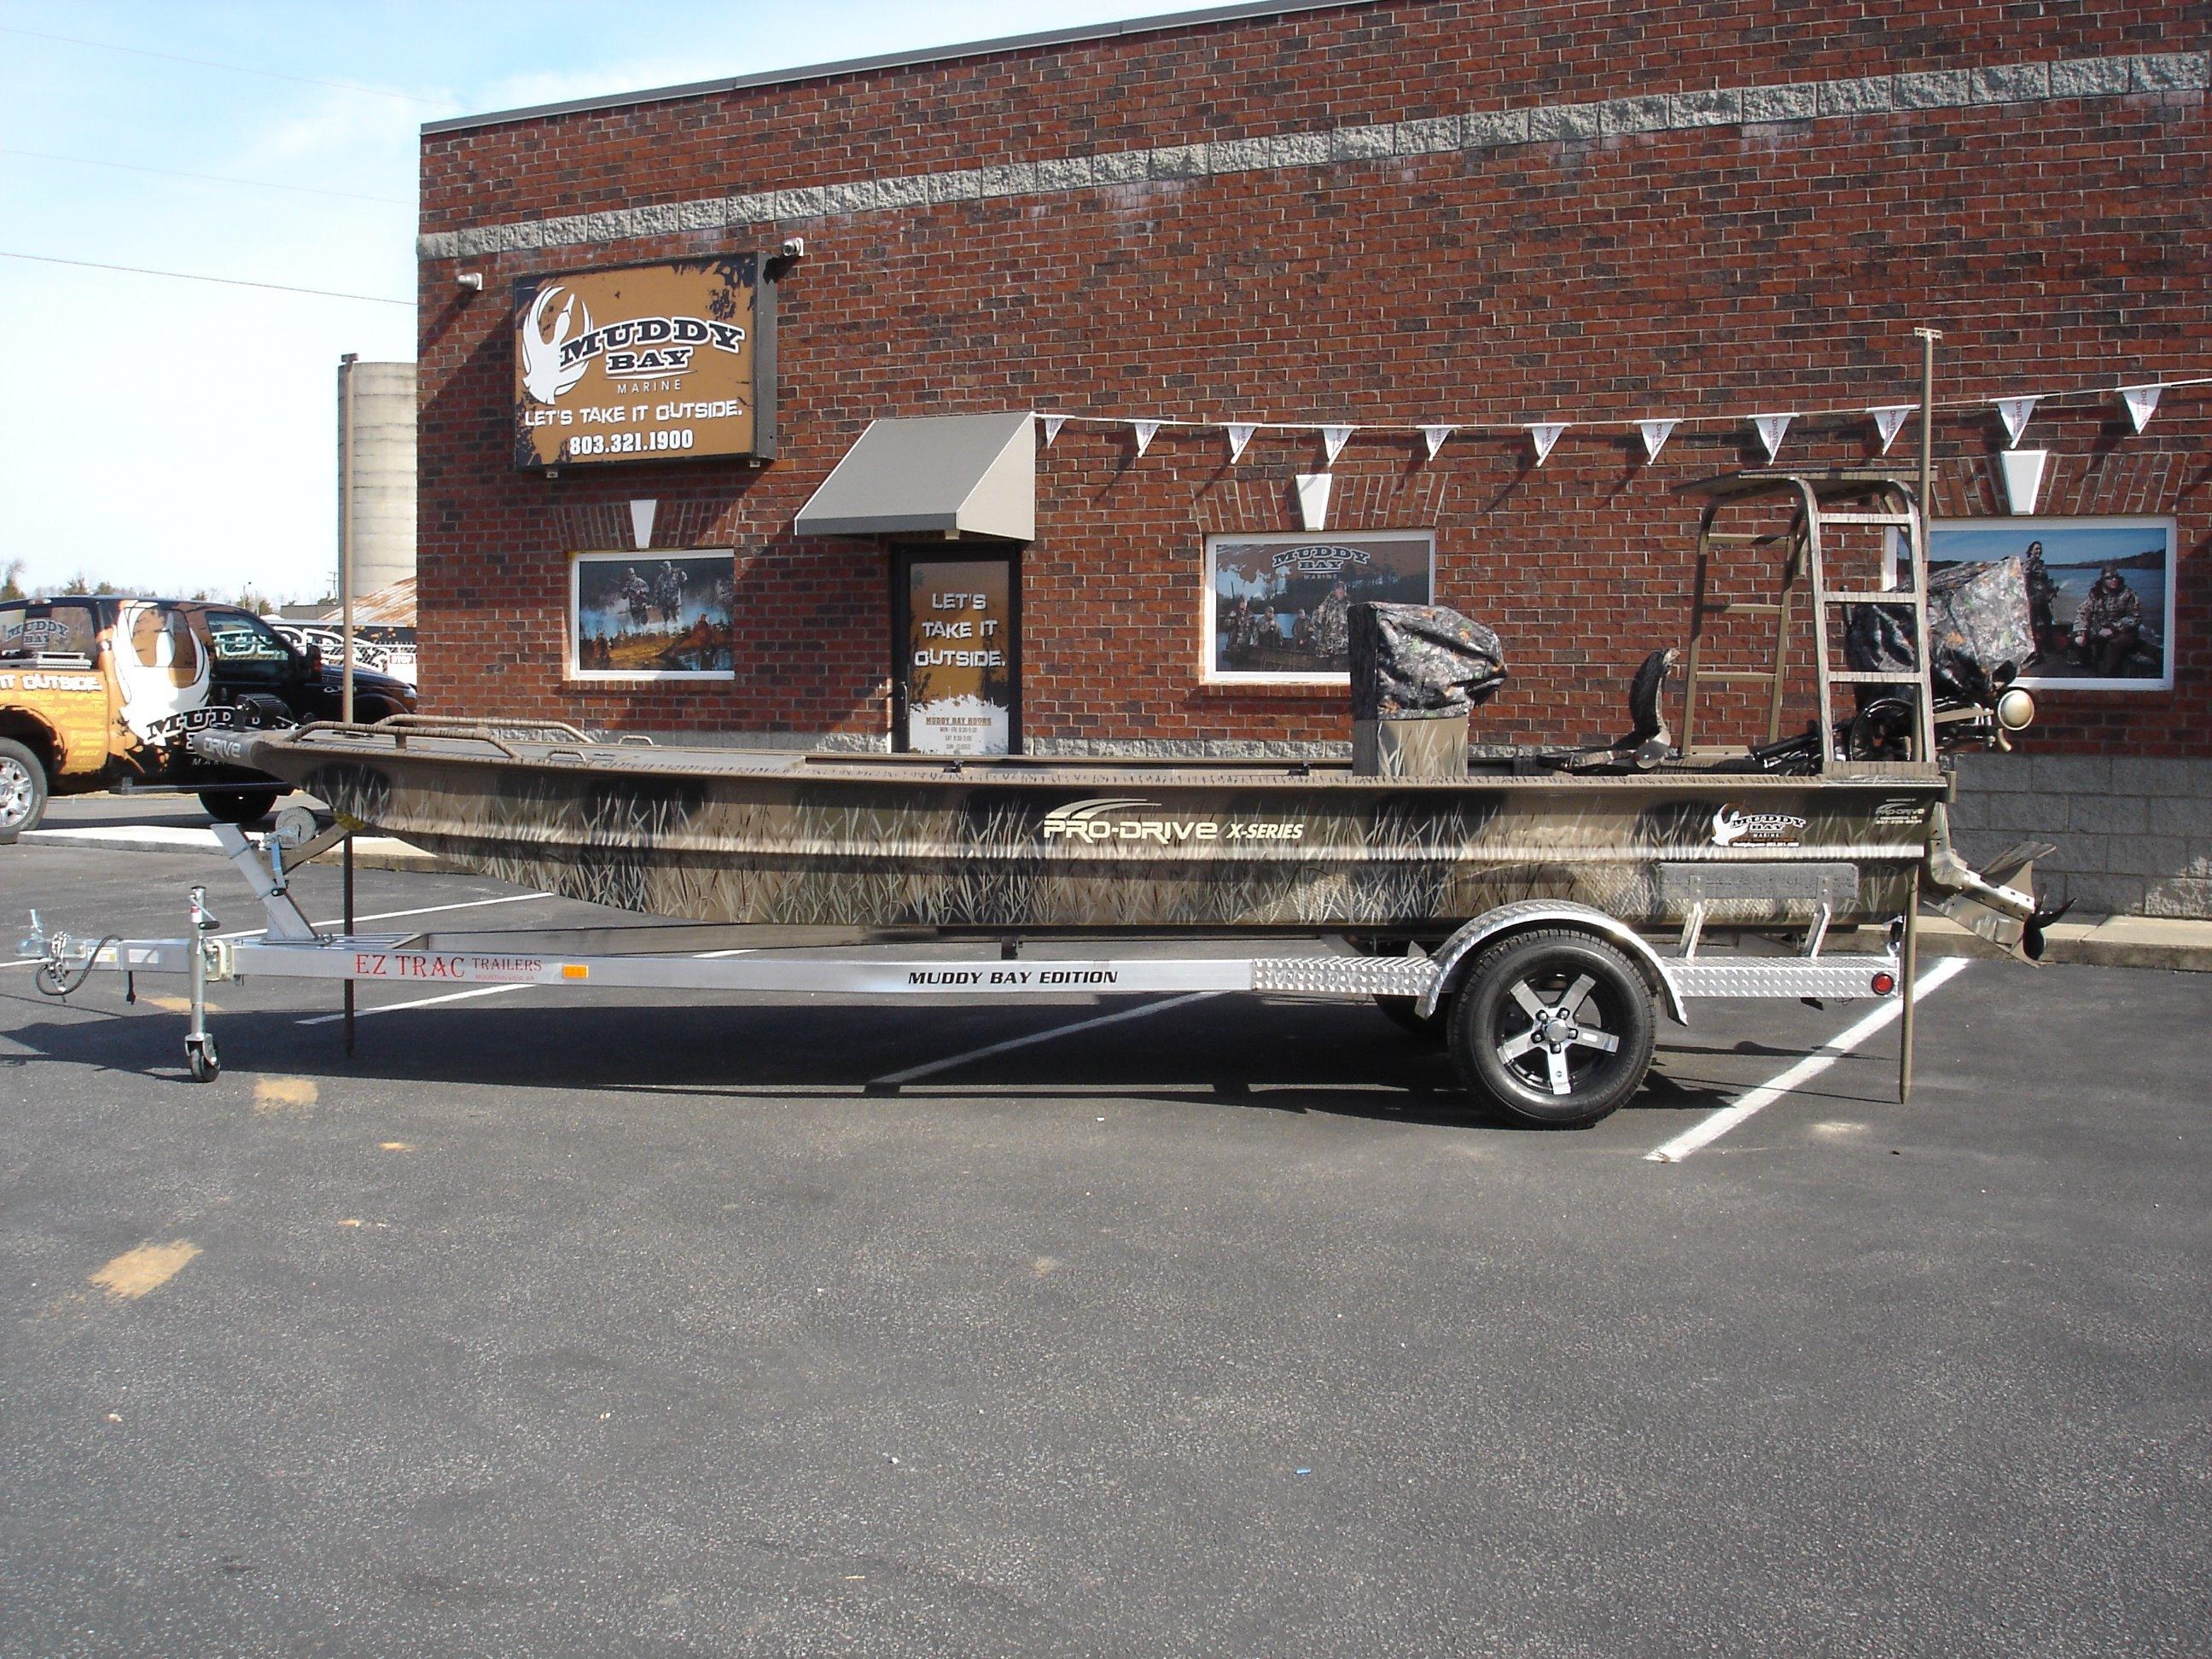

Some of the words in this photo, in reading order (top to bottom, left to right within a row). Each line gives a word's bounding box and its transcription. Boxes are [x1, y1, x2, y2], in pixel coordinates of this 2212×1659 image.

[558, 317, 745, 370] MUDDY
[607, 347, 692, 373] BAY
[617, 379, 682, 393] MARINE
[525, 409, 573, 427] LET'S
[579, 405, 626, 424] TAKE
[632, 405, 649, 422] IT
[655, 399, 742, 421] OUTSIDE.
[570, 429, 694, 455] 803.321.1900
[1272, 546, 1371, 568] MUDDY
[1298, 560, 1344, 571] BAY
[931, 593, 987, 611] LET'S
[5, 619, 69, 642] MUDDY
[922, 621, 973, 639] TAKE
[980, 620, 998, 637] IT
[914, 648, 1006, 667] OUTSIDE.
[1044, 820, 1219, 844] PRO-DRIVE
[1226, 824, 1305, 840] X-SERIES
[1730, 815, 1807, 829] MUDDY
[355, 954, 387, 975] EZ
[395, 955, 465, 979] TRAC
[471, 958, 542, 972] TRAILERS
[908, 972, 983, 984] MUDDY
[990, 972, 1032, 984] BAY
[1039, 971, 1119, 984] EDITION
